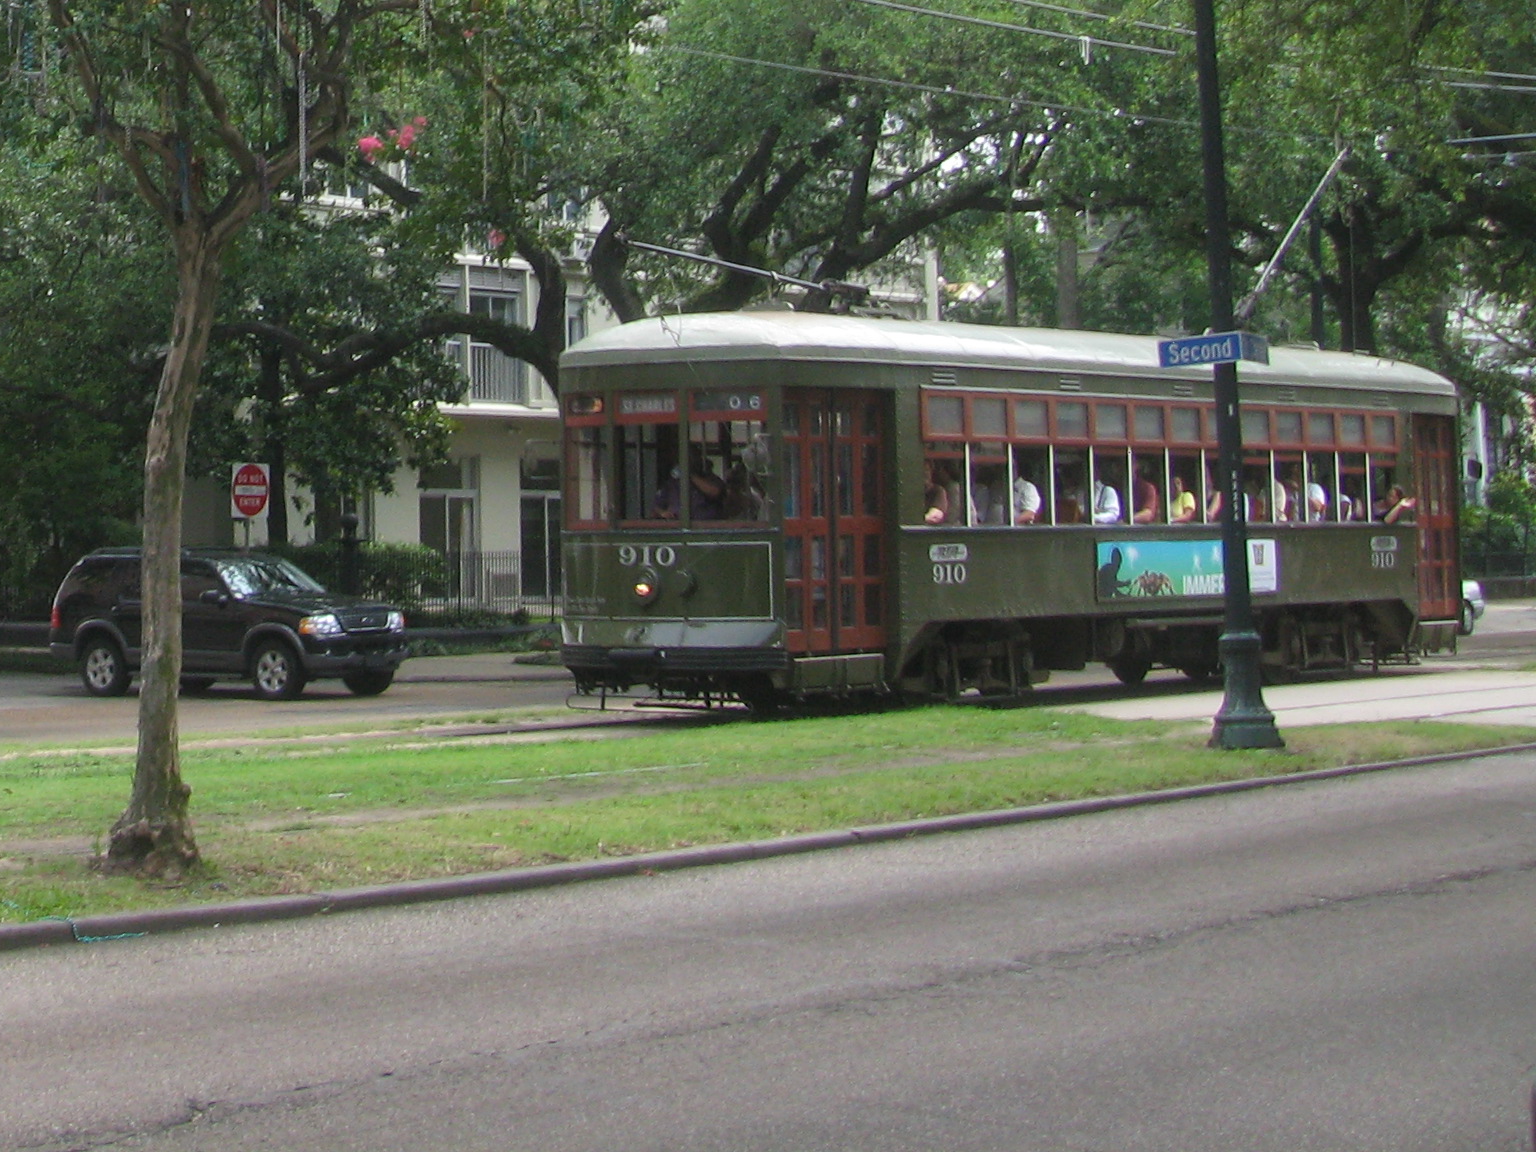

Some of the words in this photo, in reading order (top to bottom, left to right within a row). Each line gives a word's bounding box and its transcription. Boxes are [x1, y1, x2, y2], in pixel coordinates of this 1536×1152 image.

[1169, 338, 1232, 363] Second
[237, 474, 248, 484] DO
[250, 474, 263, 484] NOT
[239, 497, 261, 507] ENTER
[619, 546, 675, 566] 910
[1371, 552, 1395, 568] 910
[933, 563, 966, 584] 910
